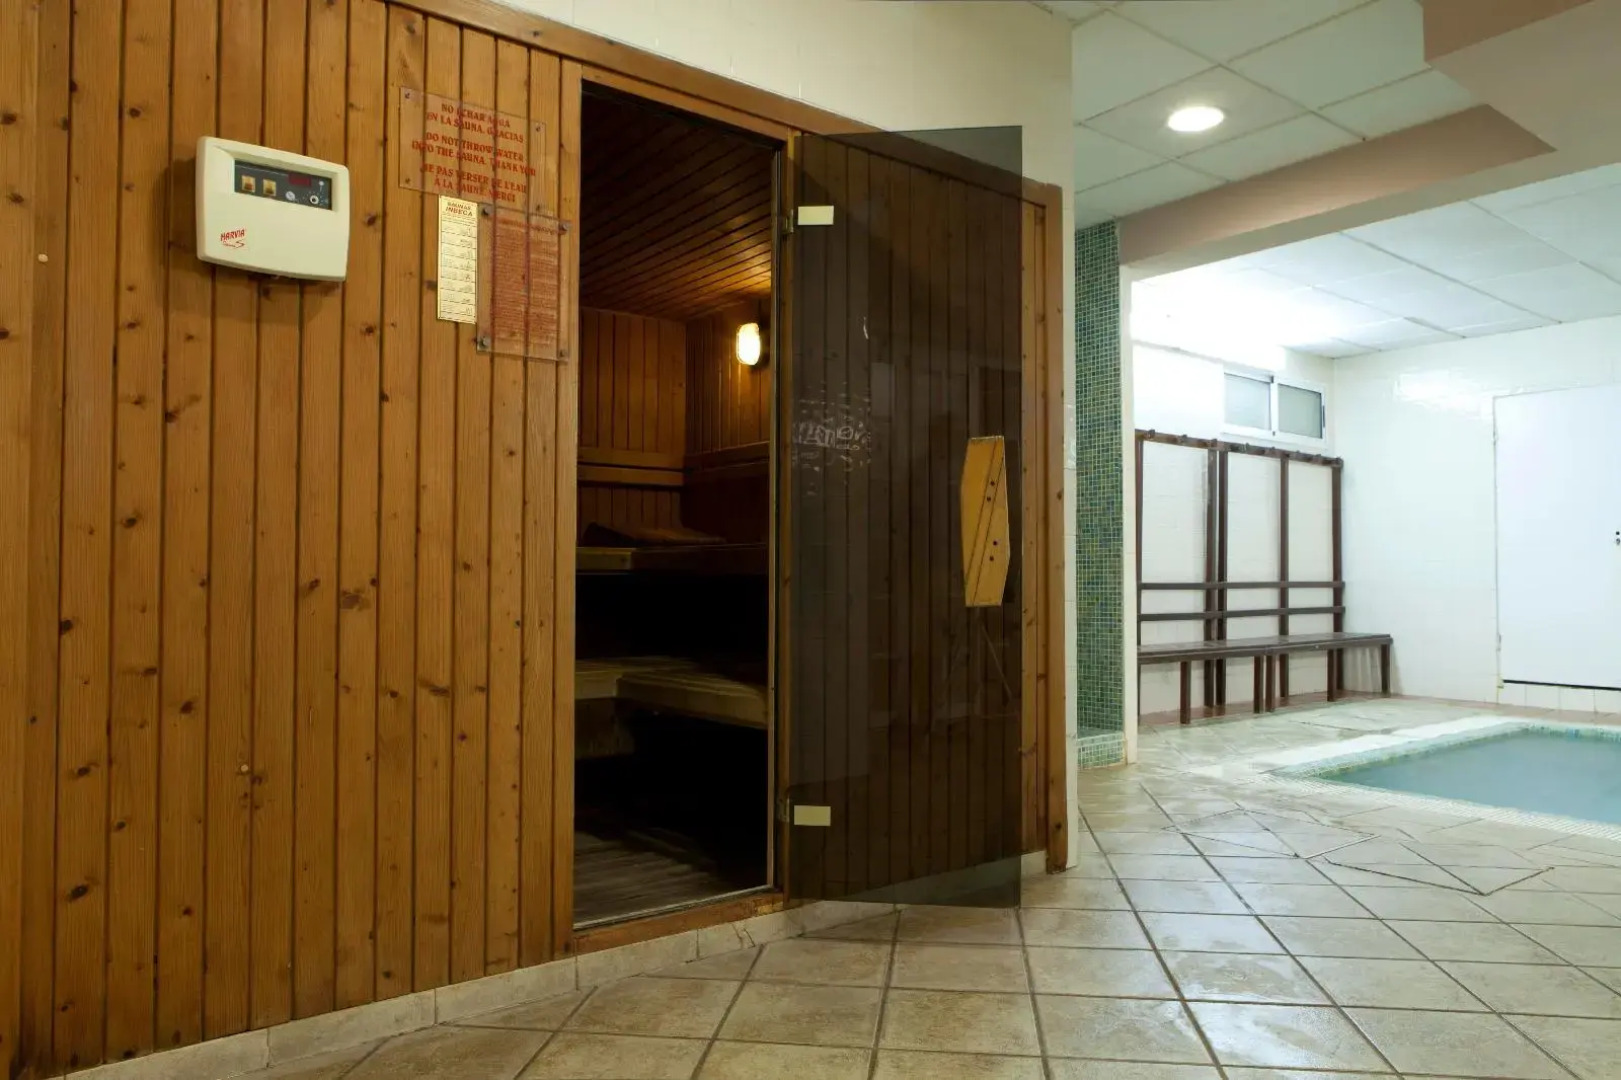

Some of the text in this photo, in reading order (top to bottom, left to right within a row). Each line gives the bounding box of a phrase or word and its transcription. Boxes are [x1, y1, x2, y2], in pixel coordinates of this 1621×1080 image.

[427, 112, 438, 121] EN
[441, 115, 452, 126] LA
[441, 103, 454, 113] NO
[457, 108, 485, 121] ECHAR
[426, 132, 524, 162] DO NOT THROW WATER
[436, 146, 454, 157] THE
[490, 158, 518, 172] THANK
[520, 165, 536, 176] YOU
[436, 166, 454, 177] PAS
[456, 170, 489, 184] VERSER
[443, 178, 453, 190] LA
[446, 207, 473, 217] INBECA
[220, 229, 245, 241] HARVIA
